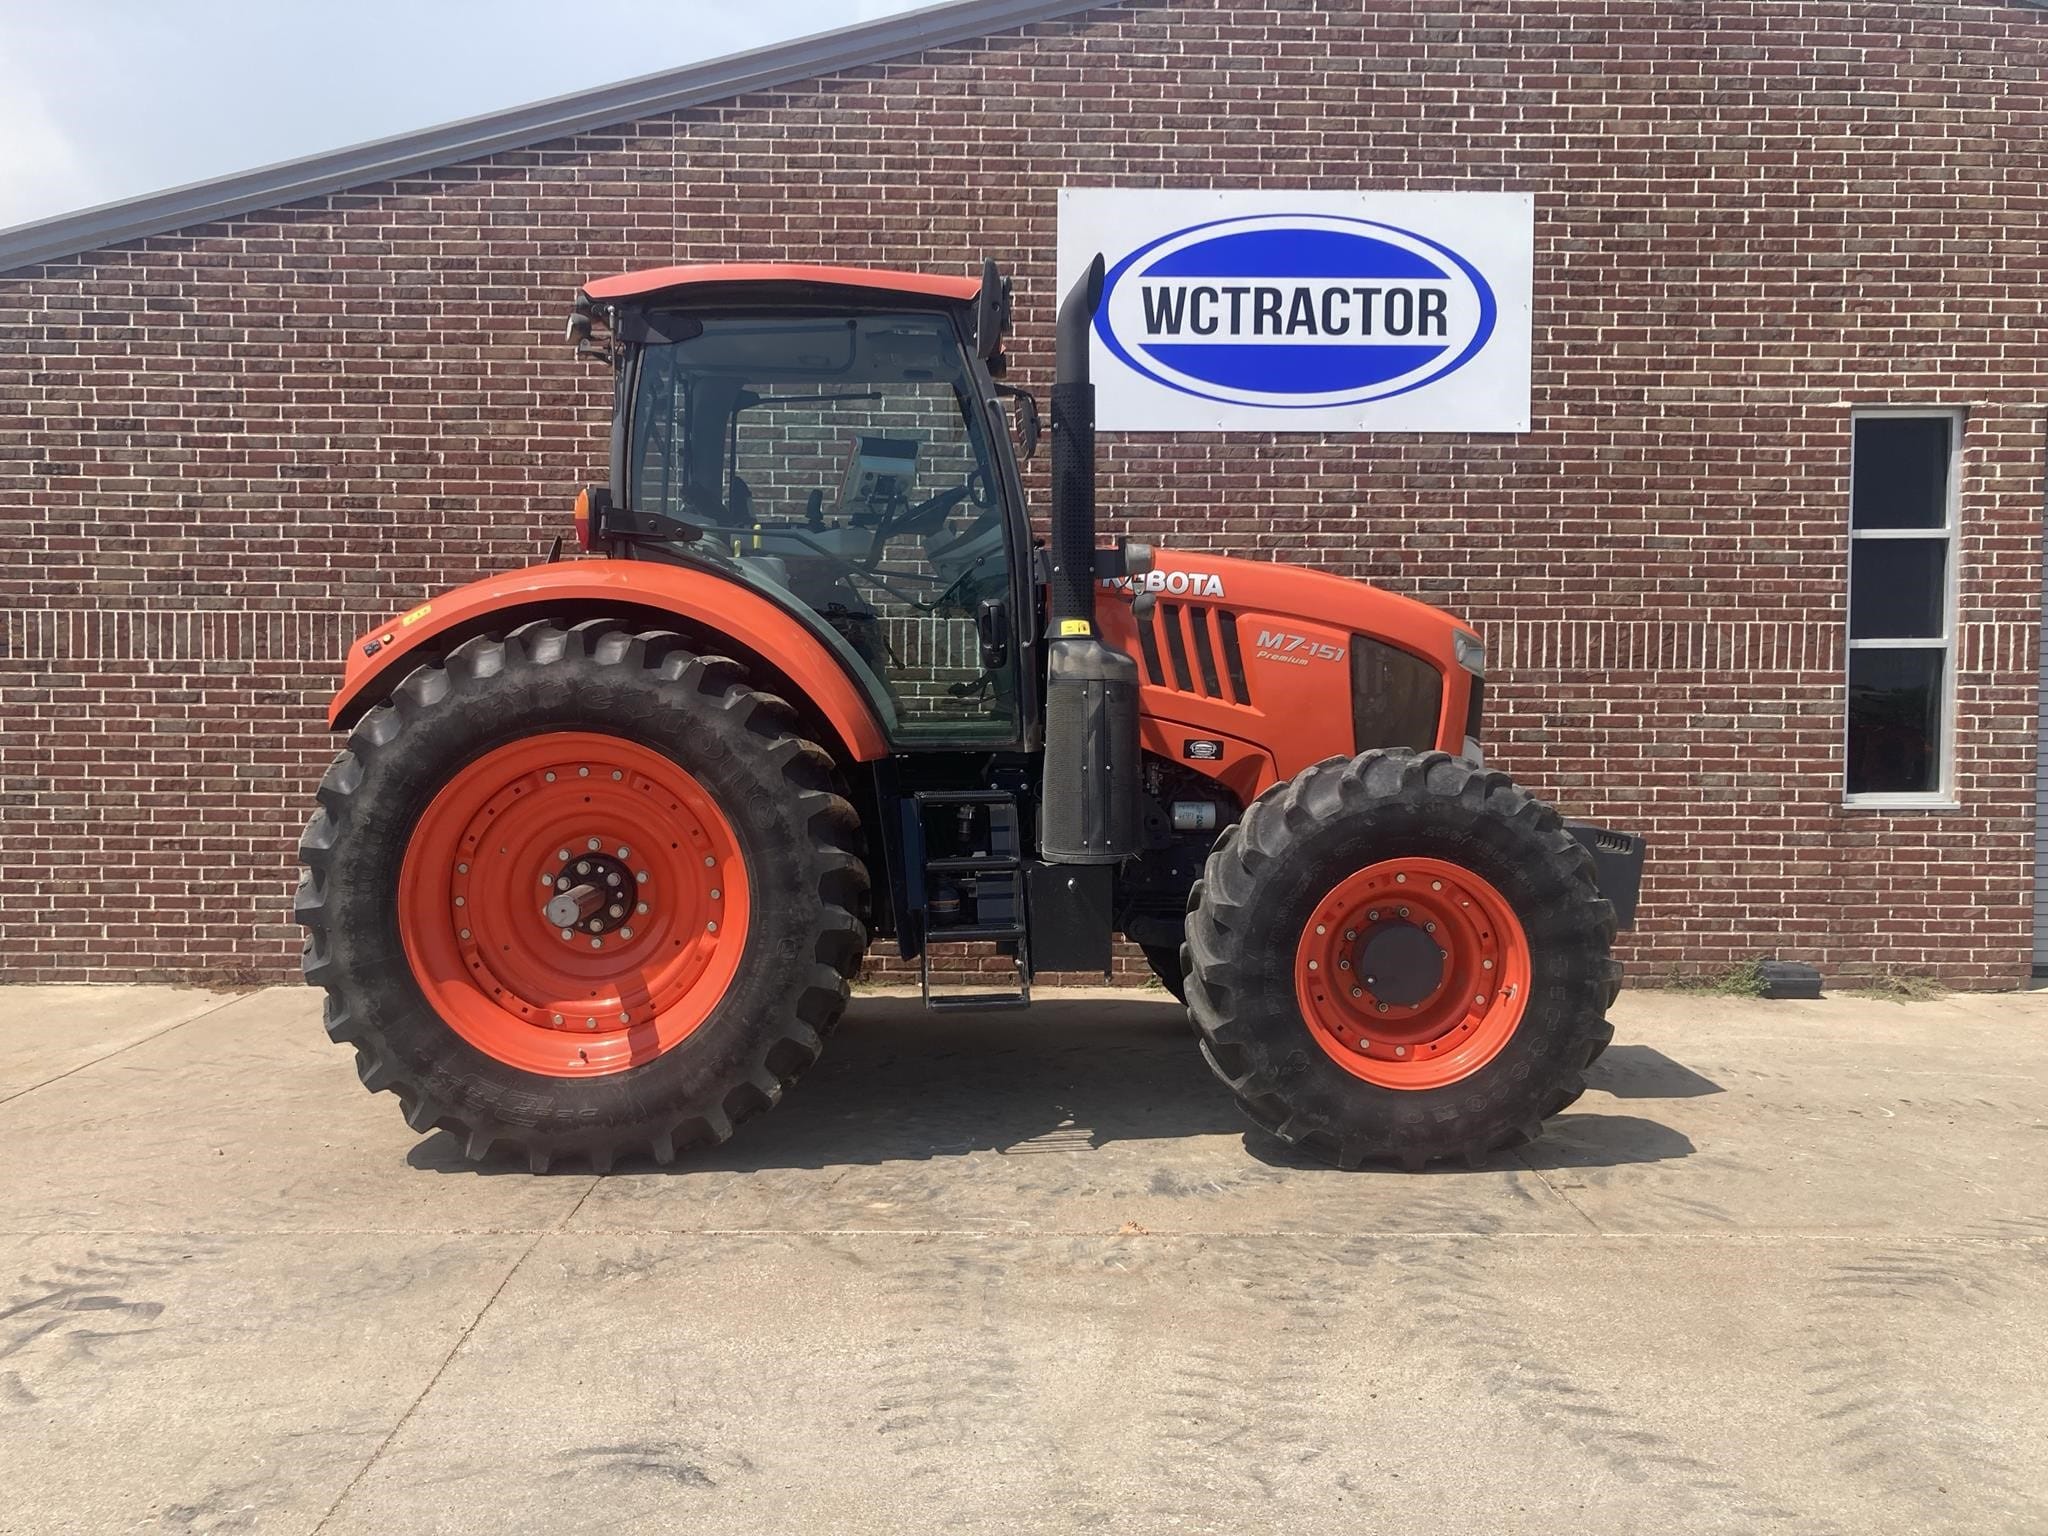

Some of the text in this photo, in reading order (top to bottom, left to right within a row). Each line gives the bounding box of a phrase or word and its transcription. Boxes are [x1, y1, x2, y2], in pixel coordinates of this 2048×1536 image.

[1142, 286, 1448, 336] WCTRACTOR
[1256, 630, 1345, 662] M7-151
[1256, 650, 1309, 666] Premium
